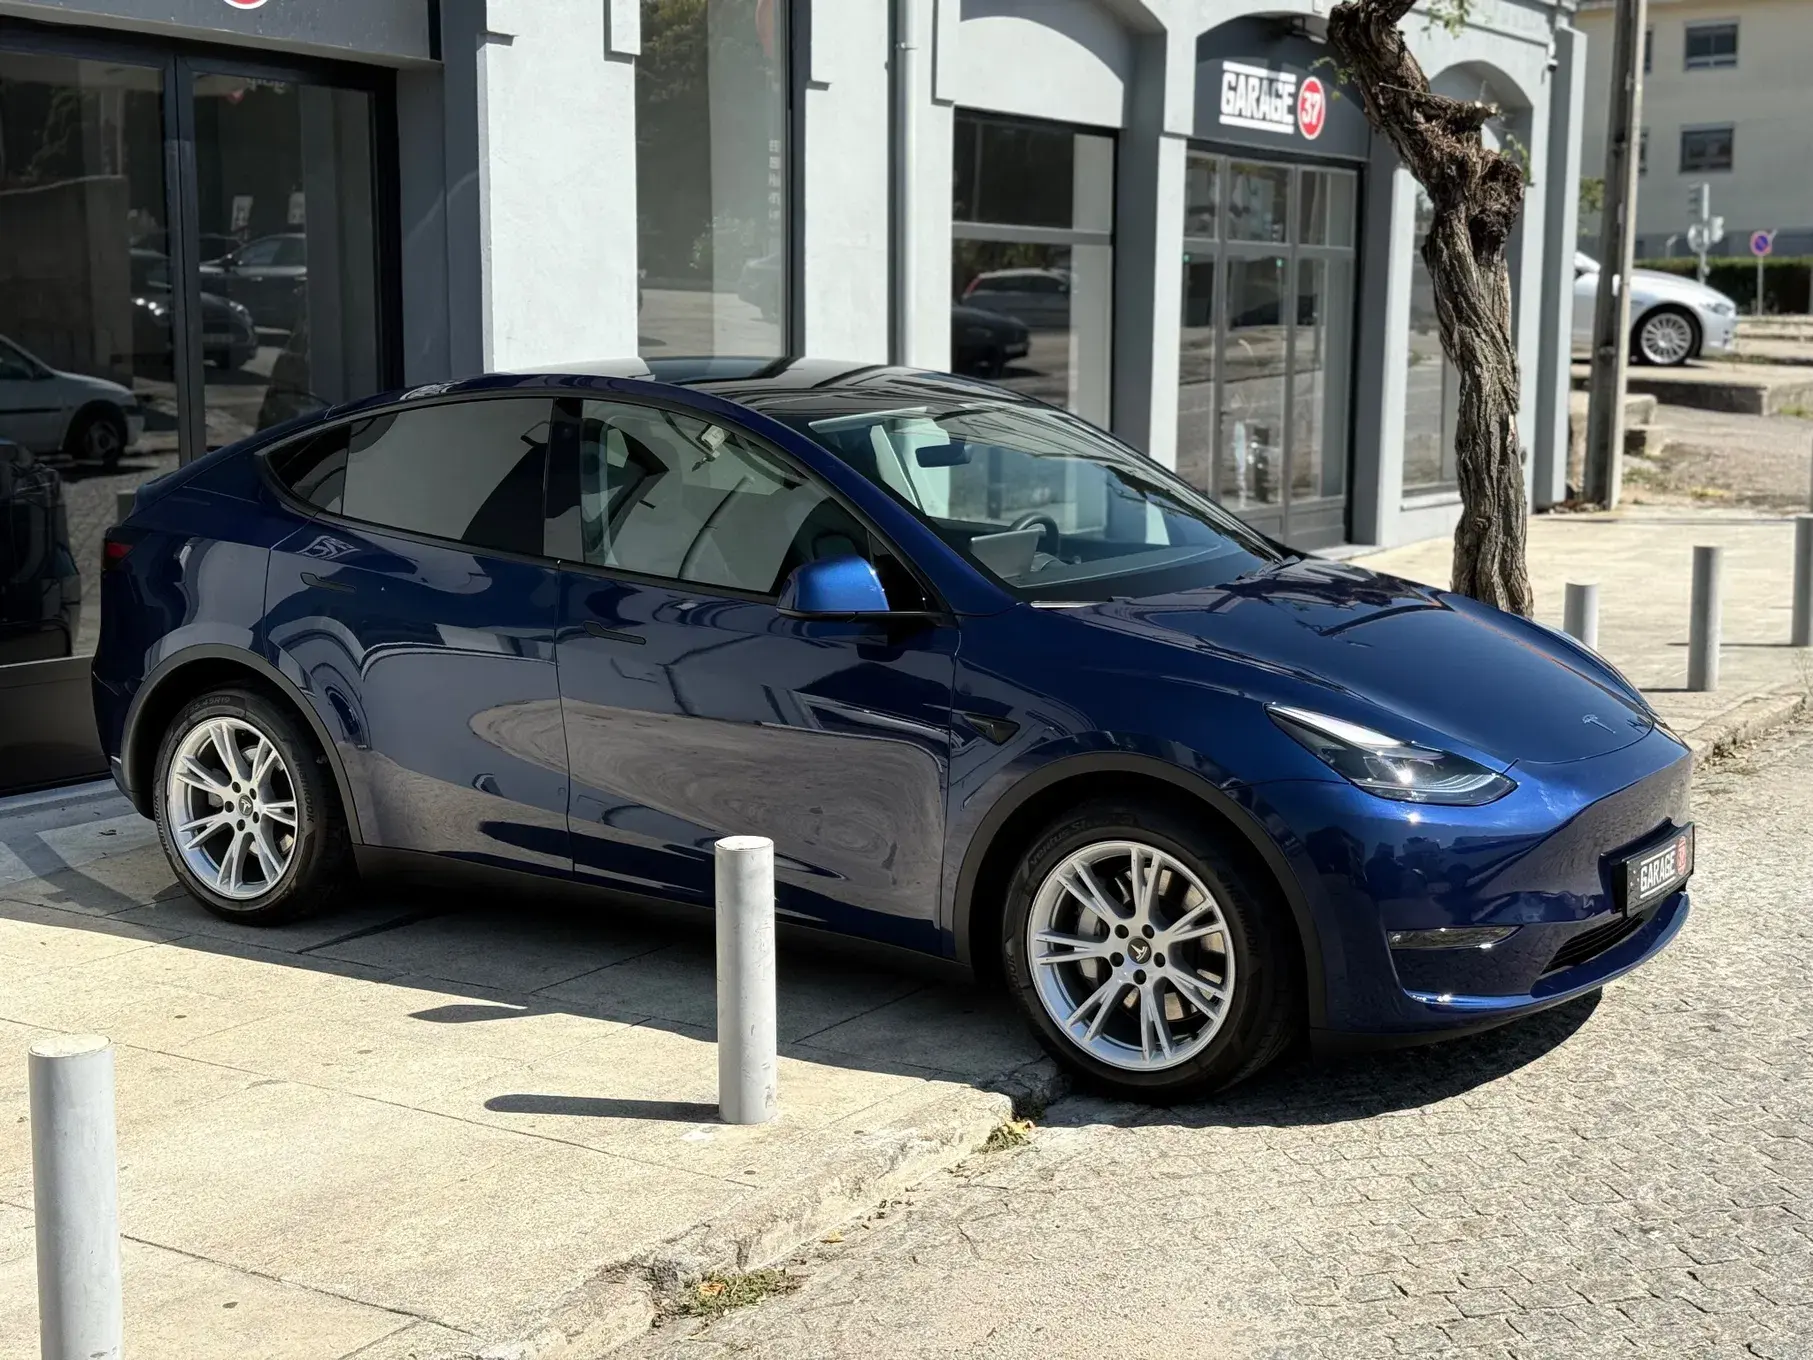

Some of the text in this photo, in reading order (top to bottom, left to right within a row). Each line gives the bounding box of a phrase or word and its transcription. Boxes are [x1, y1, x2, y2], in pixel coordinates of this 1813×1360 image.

[1221, 72, 1321, 125] GARAGE 37
[1640, 850, 1676, 892] GARAGE
